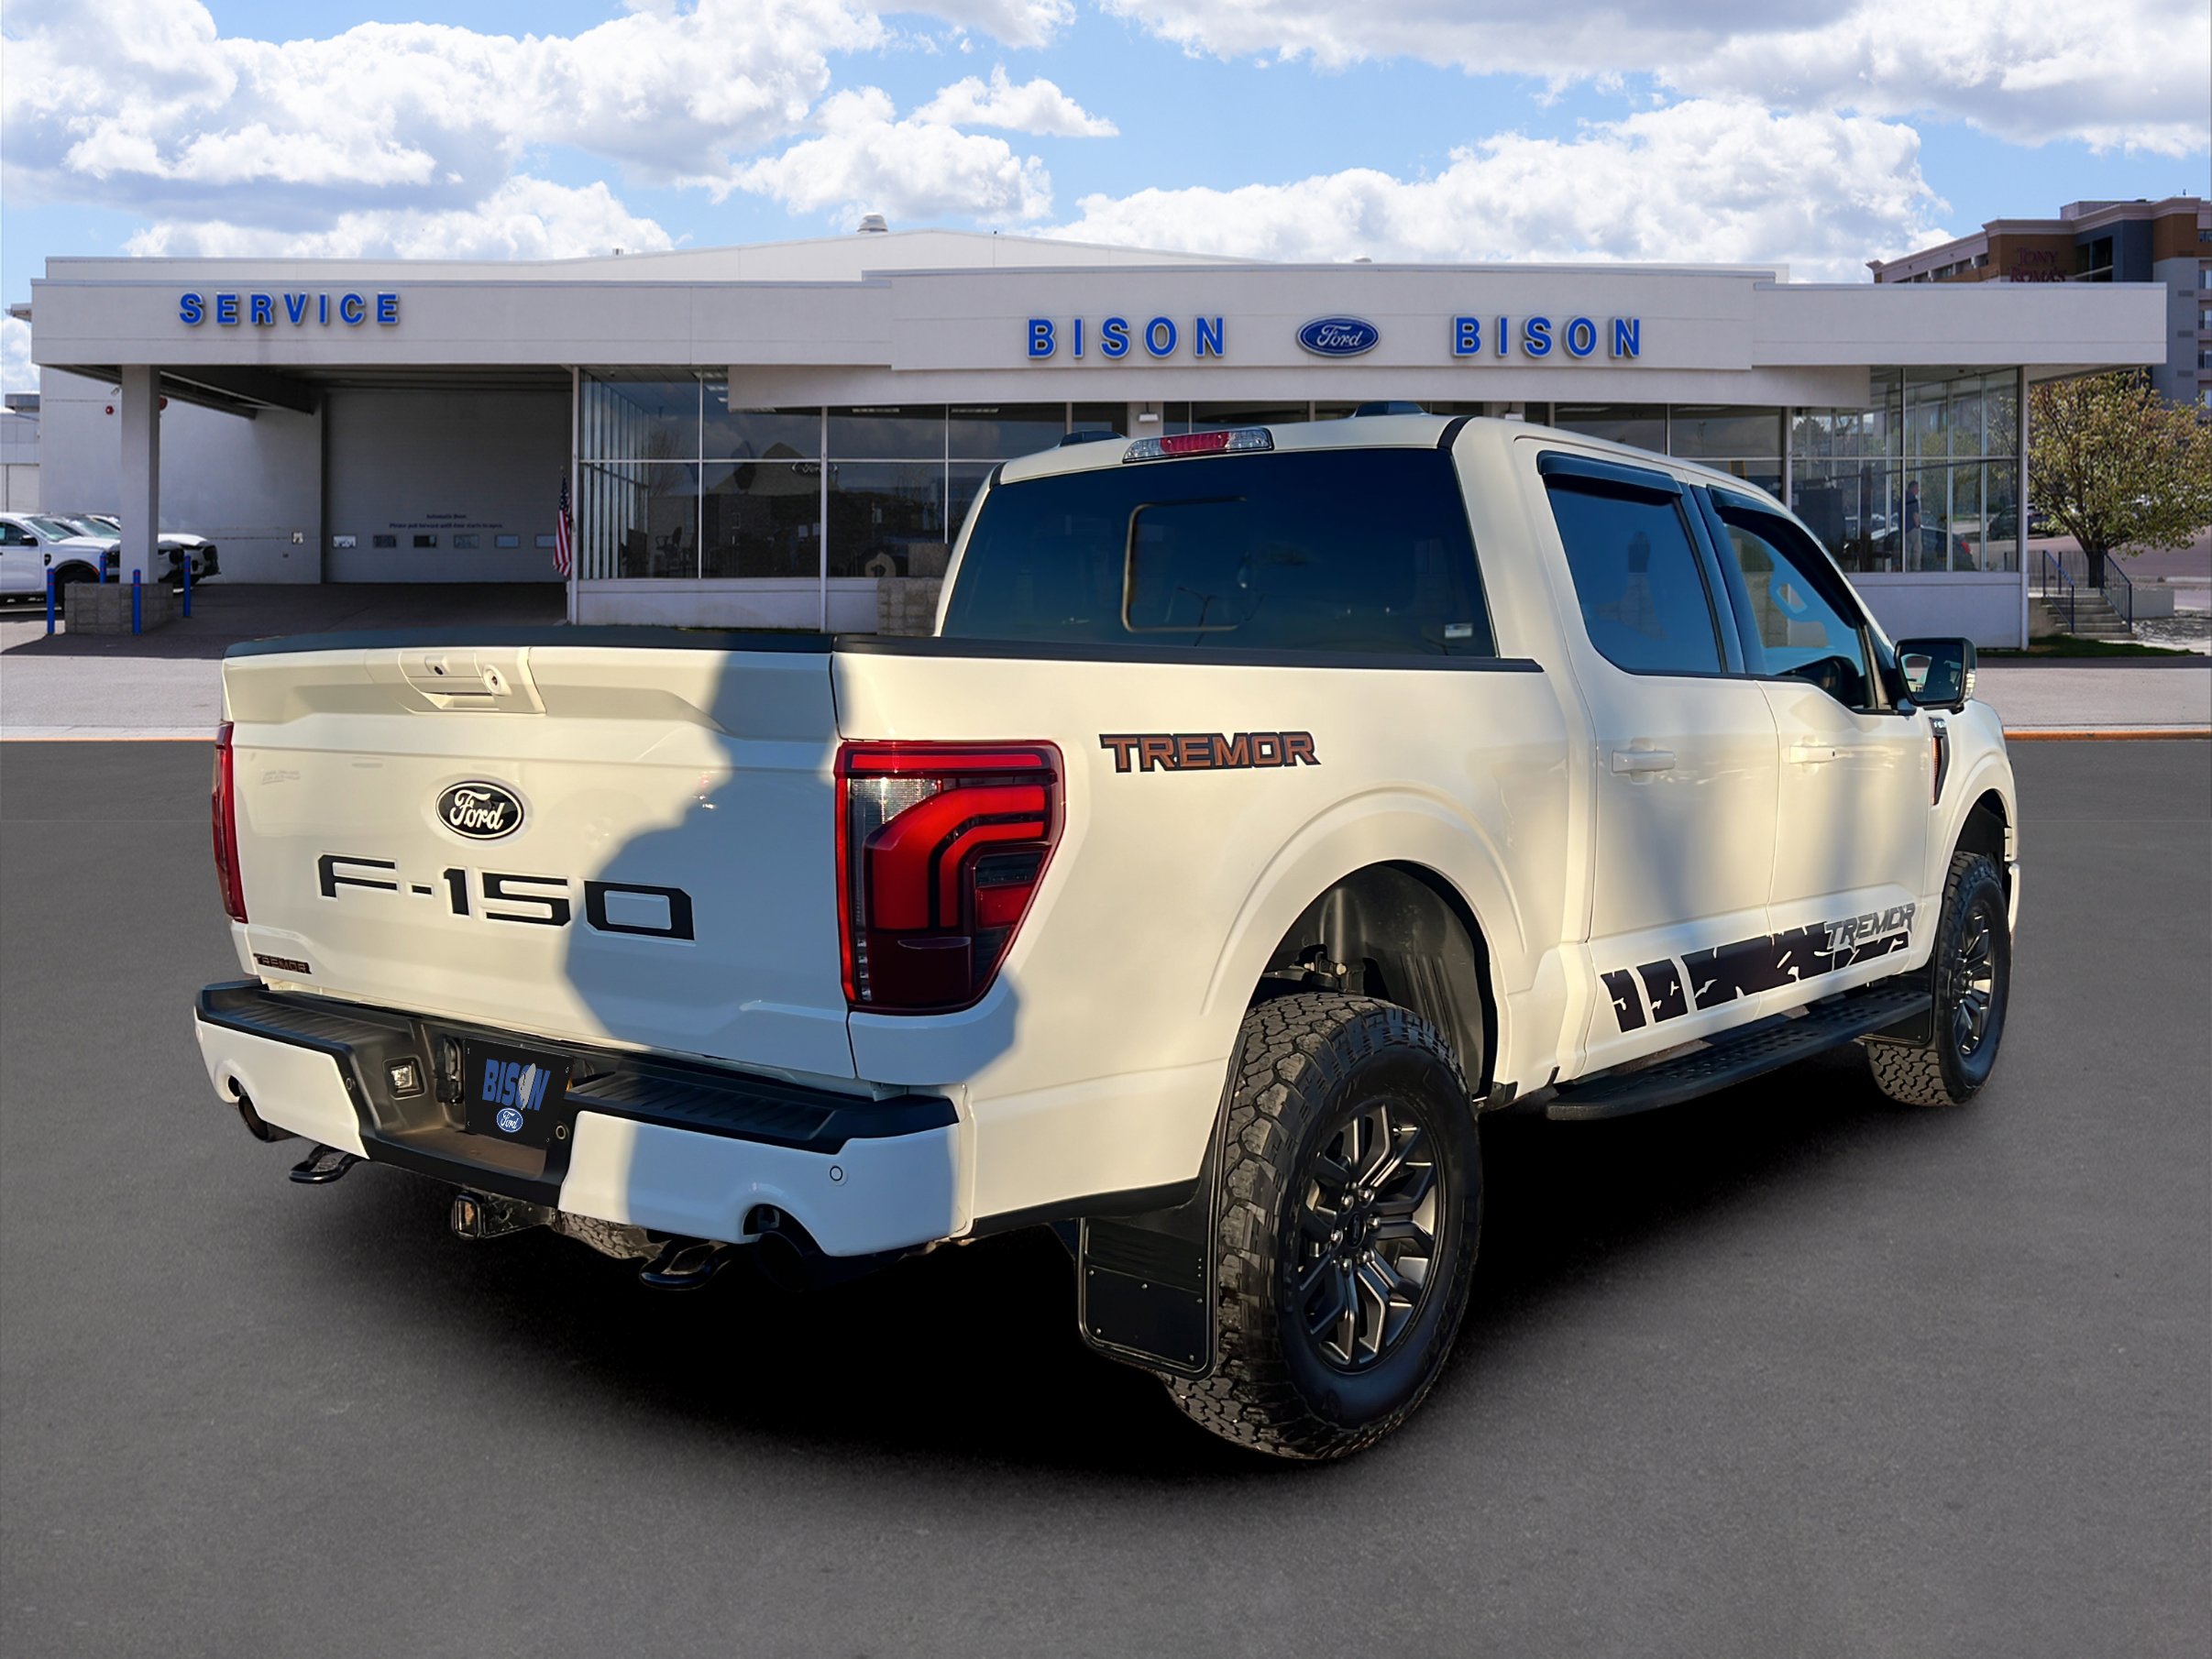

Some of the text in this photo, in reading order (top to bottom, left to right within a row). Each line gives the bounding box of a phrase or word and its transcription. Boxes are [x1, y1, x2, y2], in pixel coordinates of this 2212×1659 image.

[179, 291, 401, 325] SERVICE
[1027, 315, 1225, 359] BISON
[1316, 324, 1363, 347] Ford
[1450, 315, 1643, 359] BISON
[1099, 731, 1322, 773] TREMOR
[449, 789, 505, 830] Ford
[318, 854, 695, 940] F-150
[1825, 903, 1916, 950] TREMOR
[253, 953, 312, 974] TREMOR
[481, 1058, 551, 1112] BISON
[501, 1110, 519, 1129] Ford
